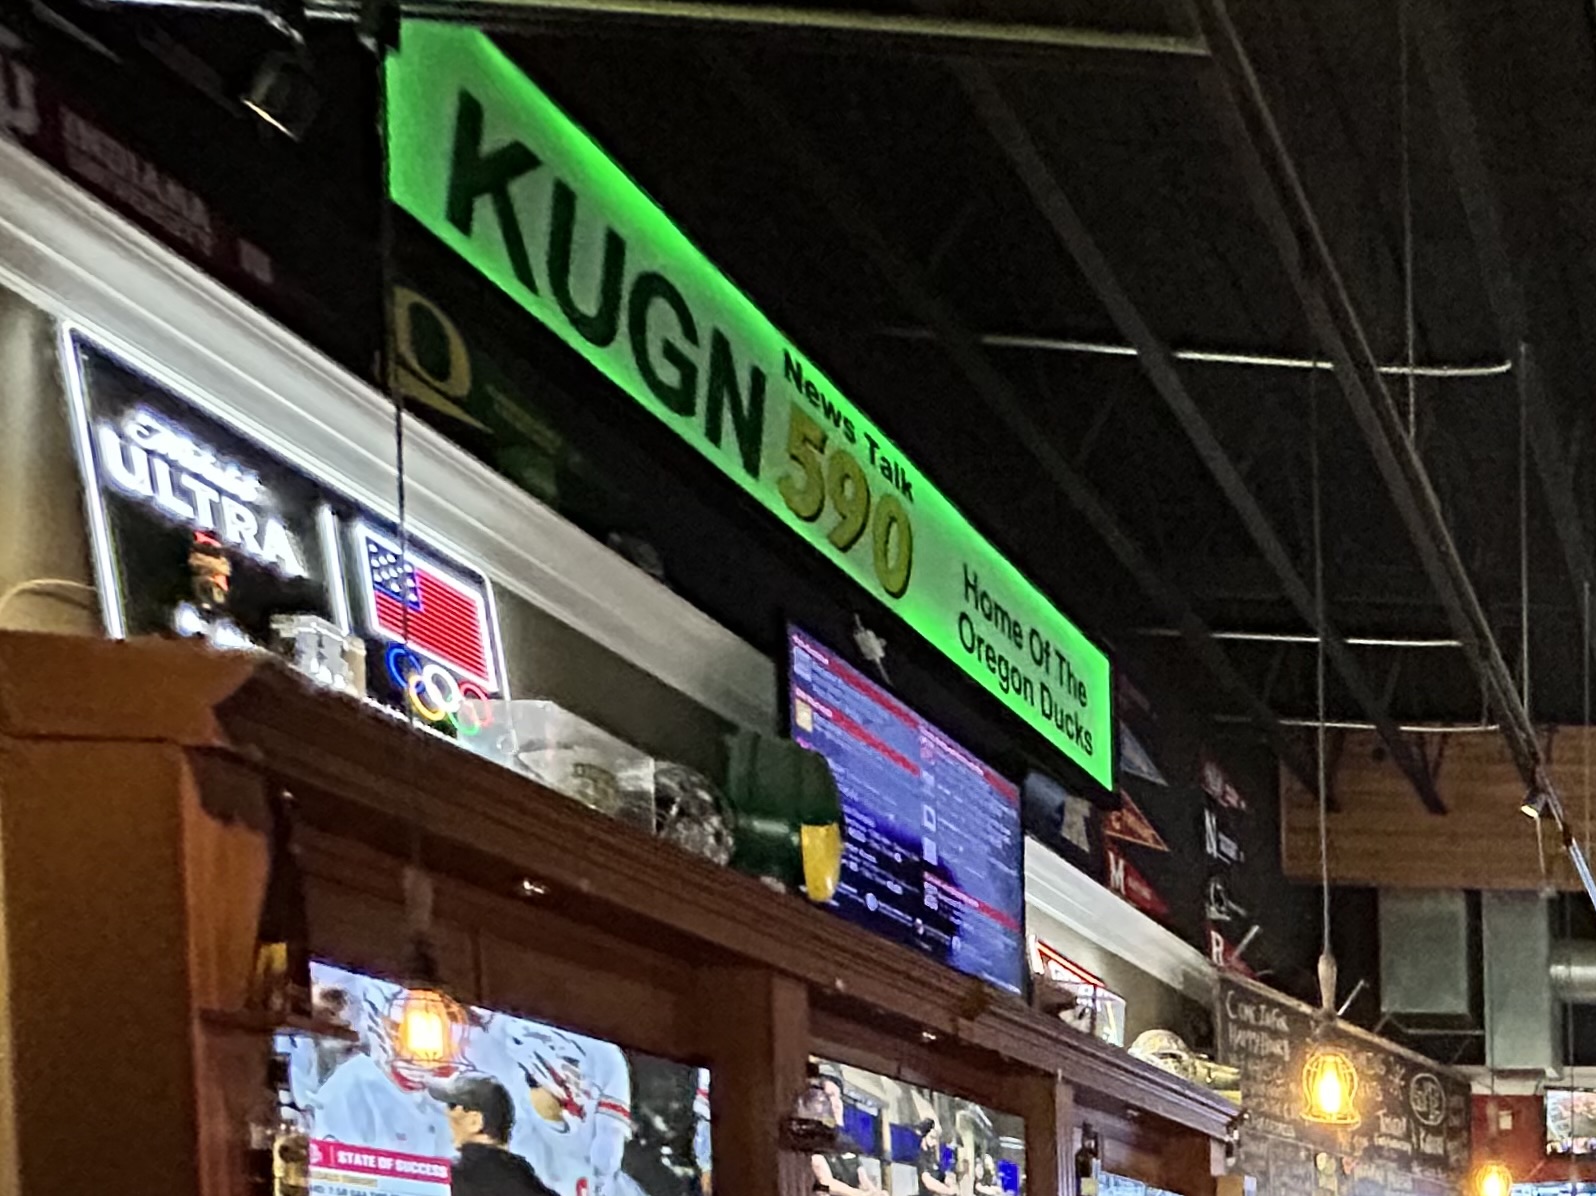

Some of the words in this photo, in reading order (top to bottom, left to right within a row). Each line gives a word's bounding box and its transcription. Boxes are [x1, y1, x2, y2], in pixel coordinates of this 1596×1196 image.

[446, 88, 766, 481] KUGN
[97, 420, 309, 579] ULTRA
[777, 401, 914, 600] 590
[783, 348, 857, 445] News
[863, 432, 914, 503] Talk
[958, 611, 1035, 707] Oregon
[1040, 681, 1093, 757] Ducks
[963, 562, 1023, 650] Home
[1029, 628, 1050, 675] Of
[1054, 648, 1088, 708] The
[337, 1150, 376, 1167] STATE
[377, 1156, 394, 1169] OF
